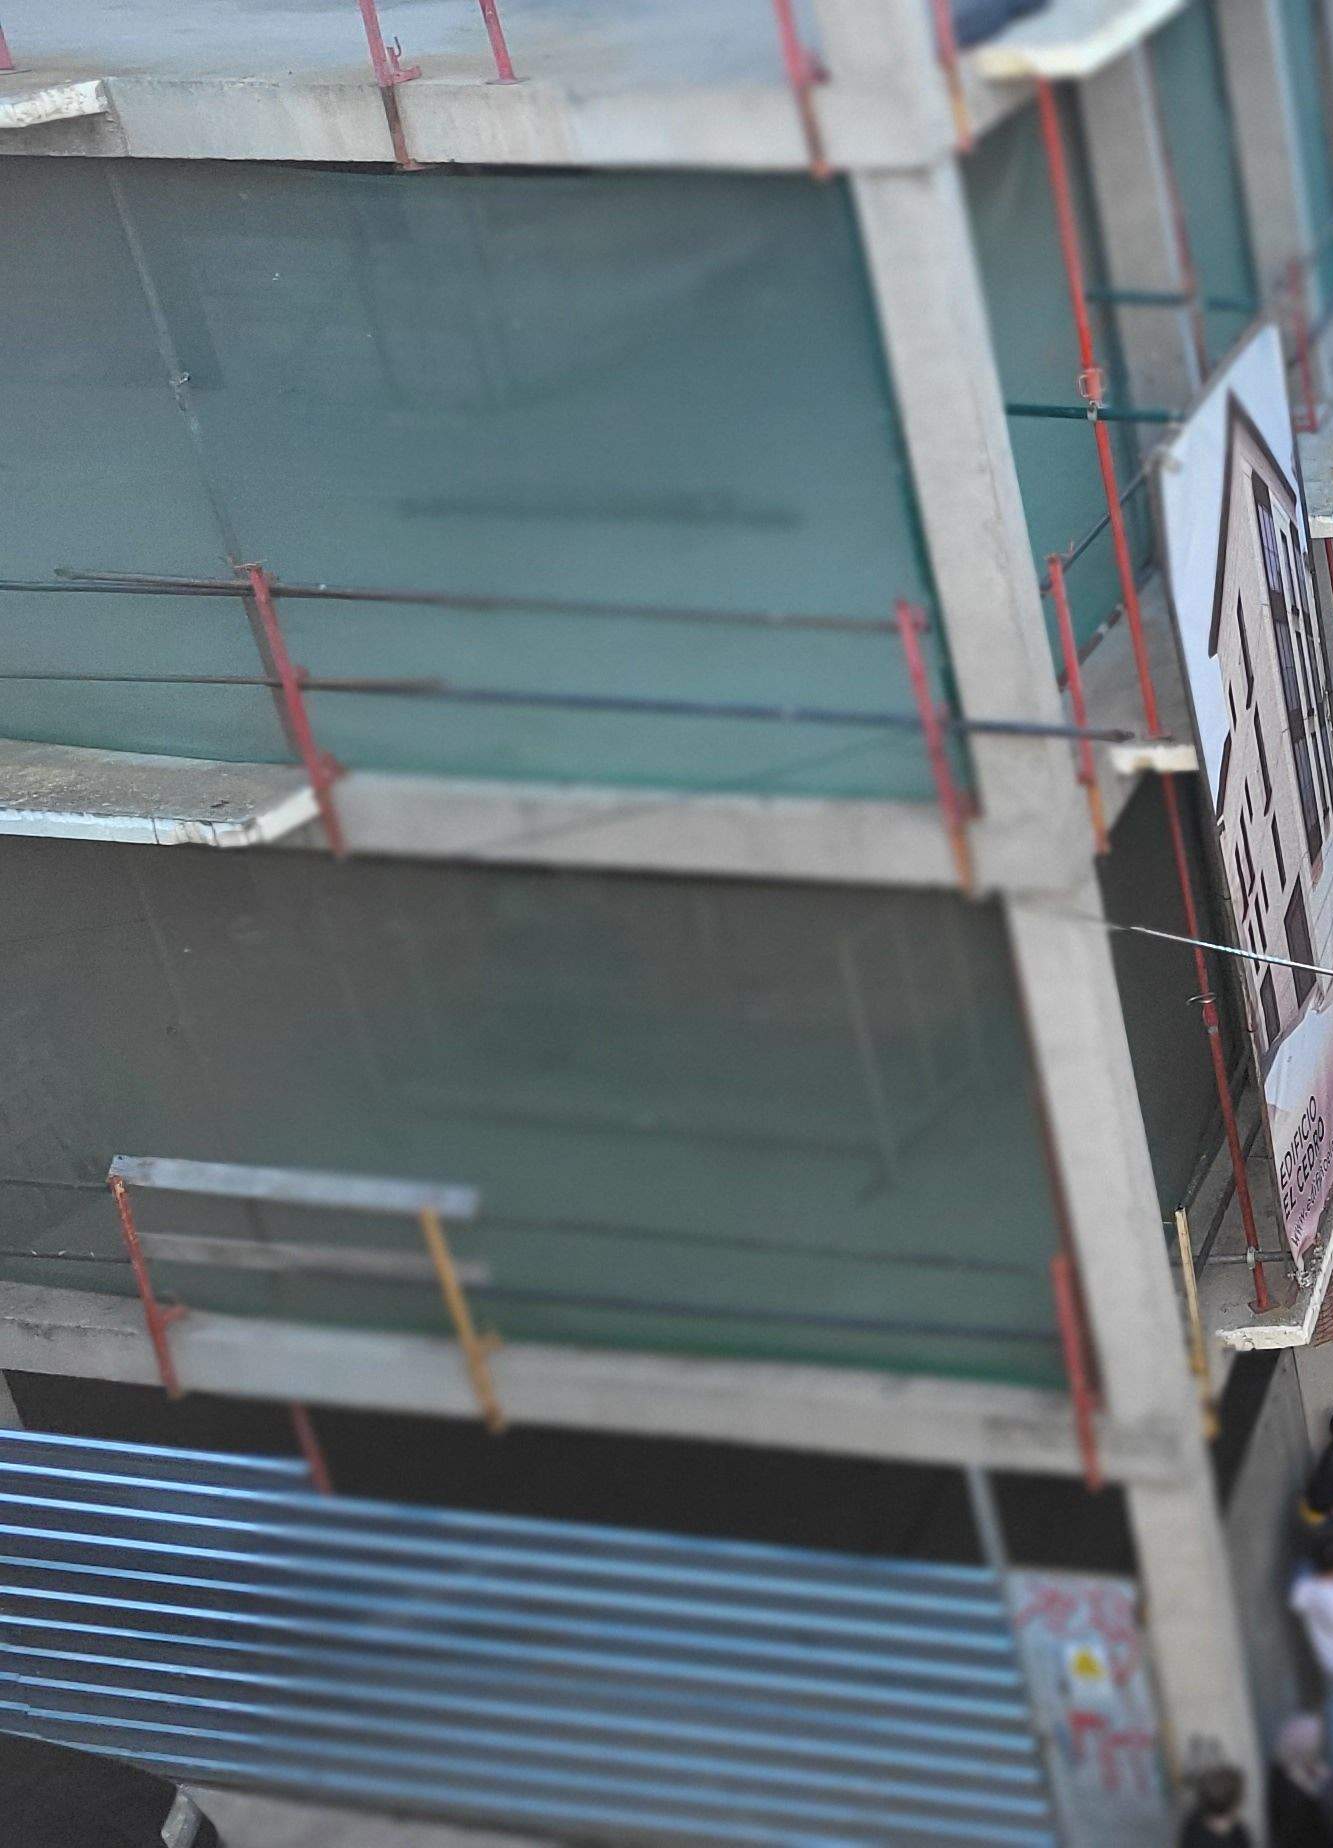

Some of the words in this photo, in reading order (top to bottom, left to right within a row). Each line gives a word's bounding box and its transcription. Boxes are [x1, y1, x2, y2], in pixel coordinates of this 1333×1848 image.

[1280, 1095, 1317, 1191] EDIFICIO
[1283, 1186, 1297, 1220] EL
[1297, 1116, 1324, 1193] CEDRO
